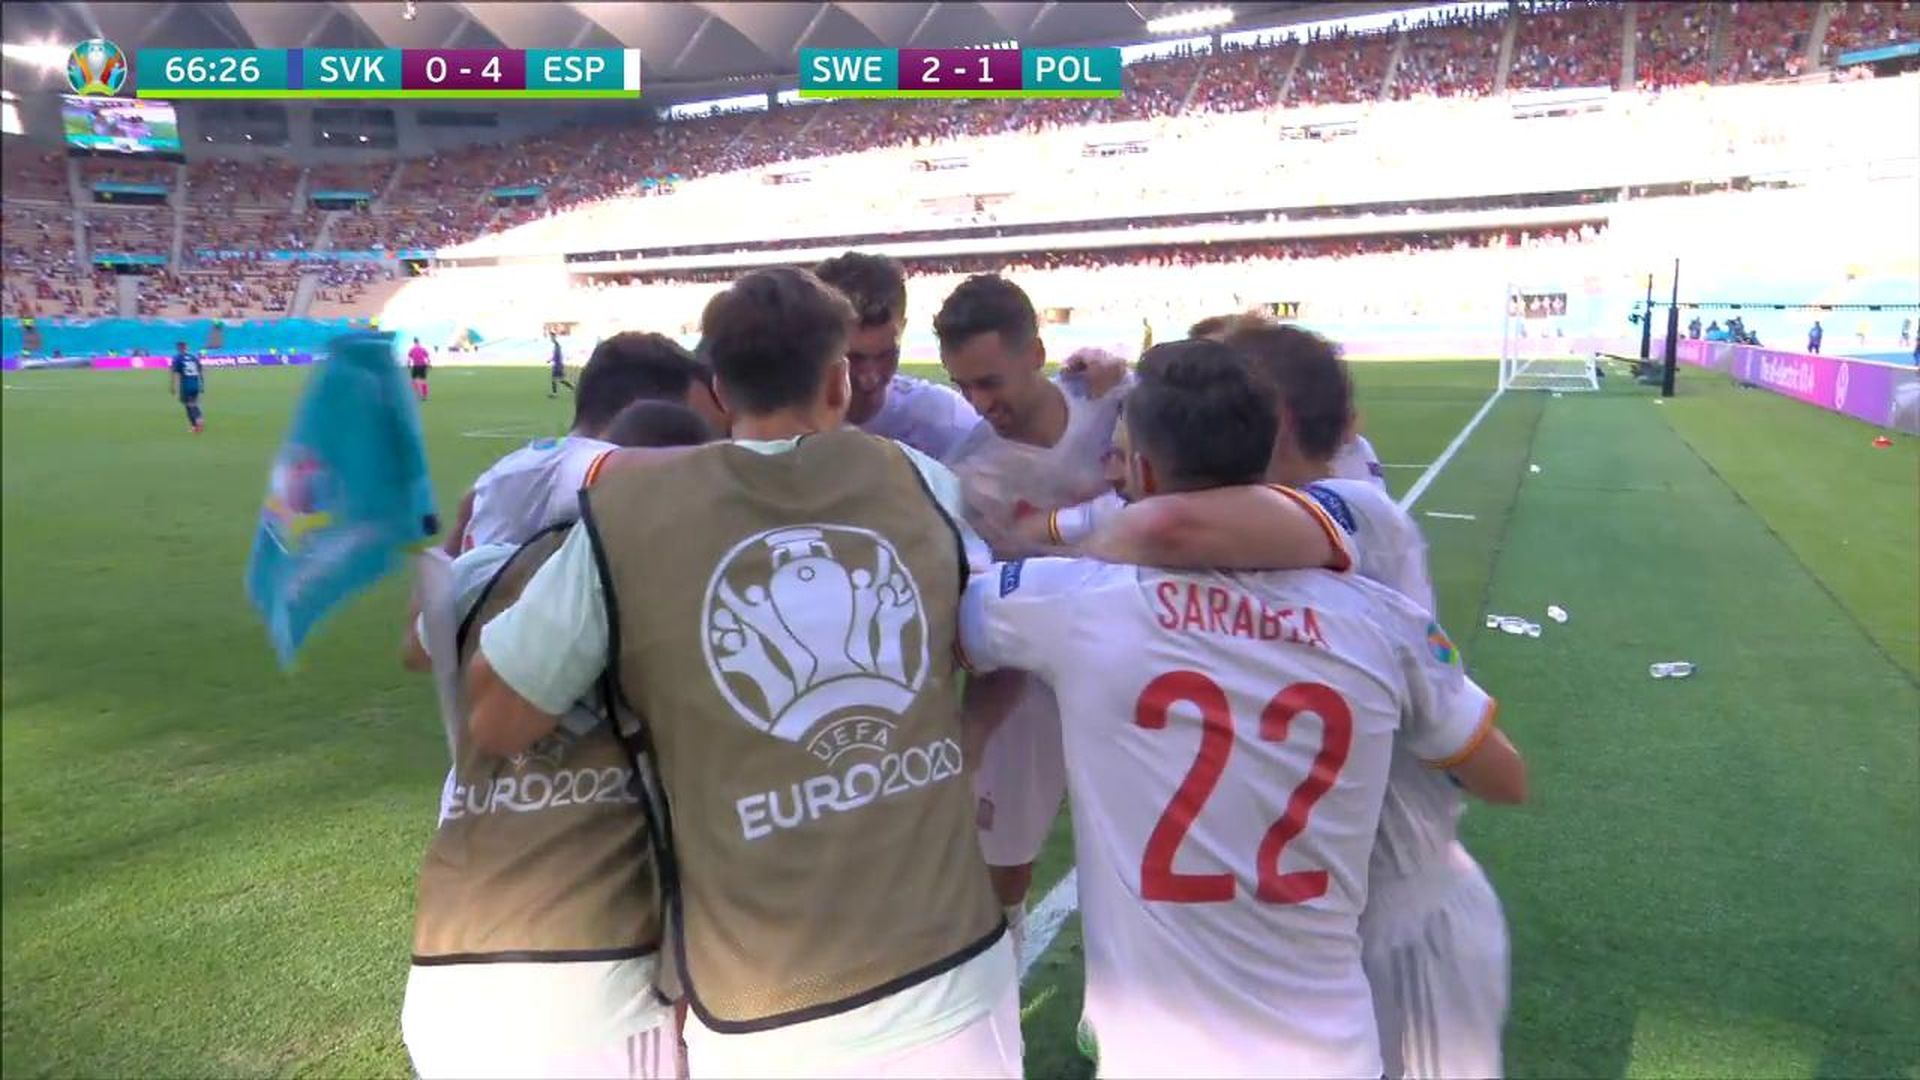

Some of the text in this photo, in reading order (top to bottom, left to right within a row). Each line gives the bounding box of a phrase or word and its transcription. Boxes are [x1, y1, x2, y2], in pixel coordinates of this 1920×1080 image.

[736, 737, 963, 841] EURO2020
[812, 722, 888, 761] UEFA
[1135, 669, 1353, 905] 22
